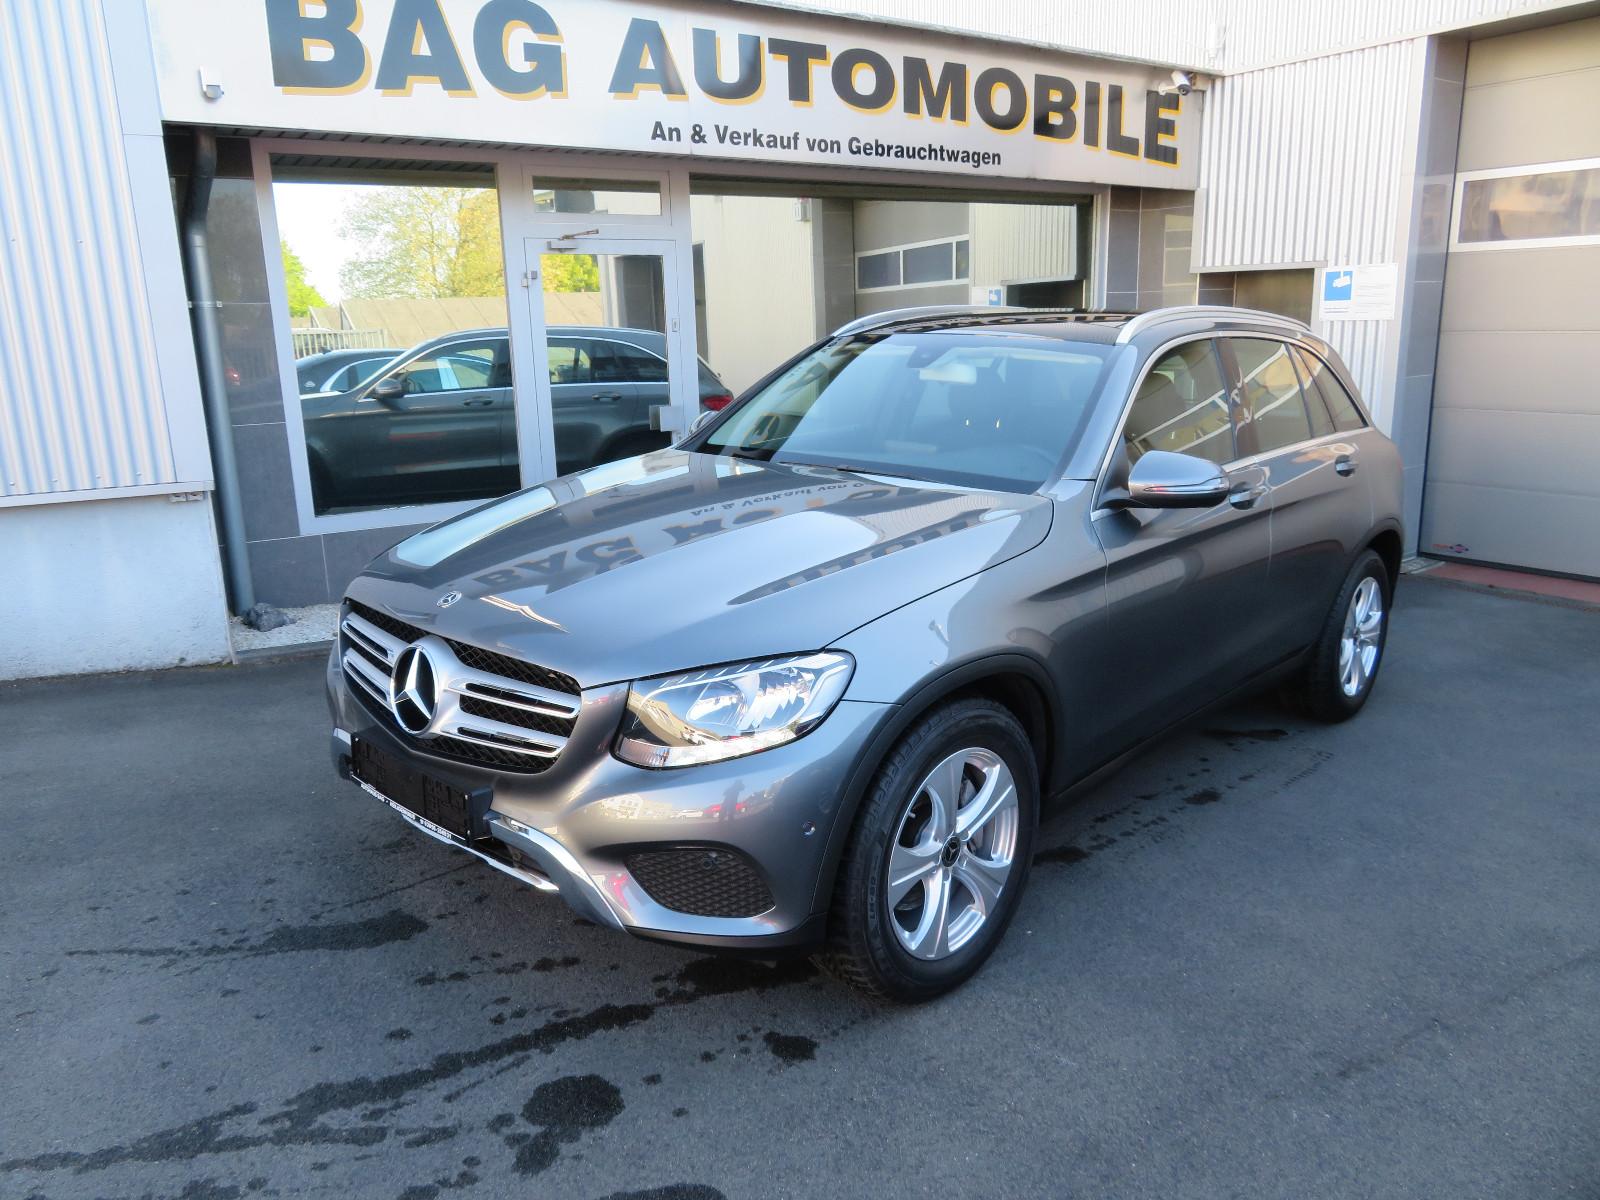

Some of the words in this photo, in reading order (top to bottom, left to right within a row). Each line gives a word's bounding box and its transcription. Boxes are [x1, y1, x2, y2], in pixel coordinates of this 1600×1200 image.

[264, 0, 568, 99] BAG
[608, 17, 1180, 168] AUTOMOBILE
[651, 120, 682, 144] An
[690, 123, 708, 145] &
[714, 124, 800, 151] Verkauf
[806, 136, 842, 156] von
[847, 137, 1002, 168] Gebrauchtwagen
